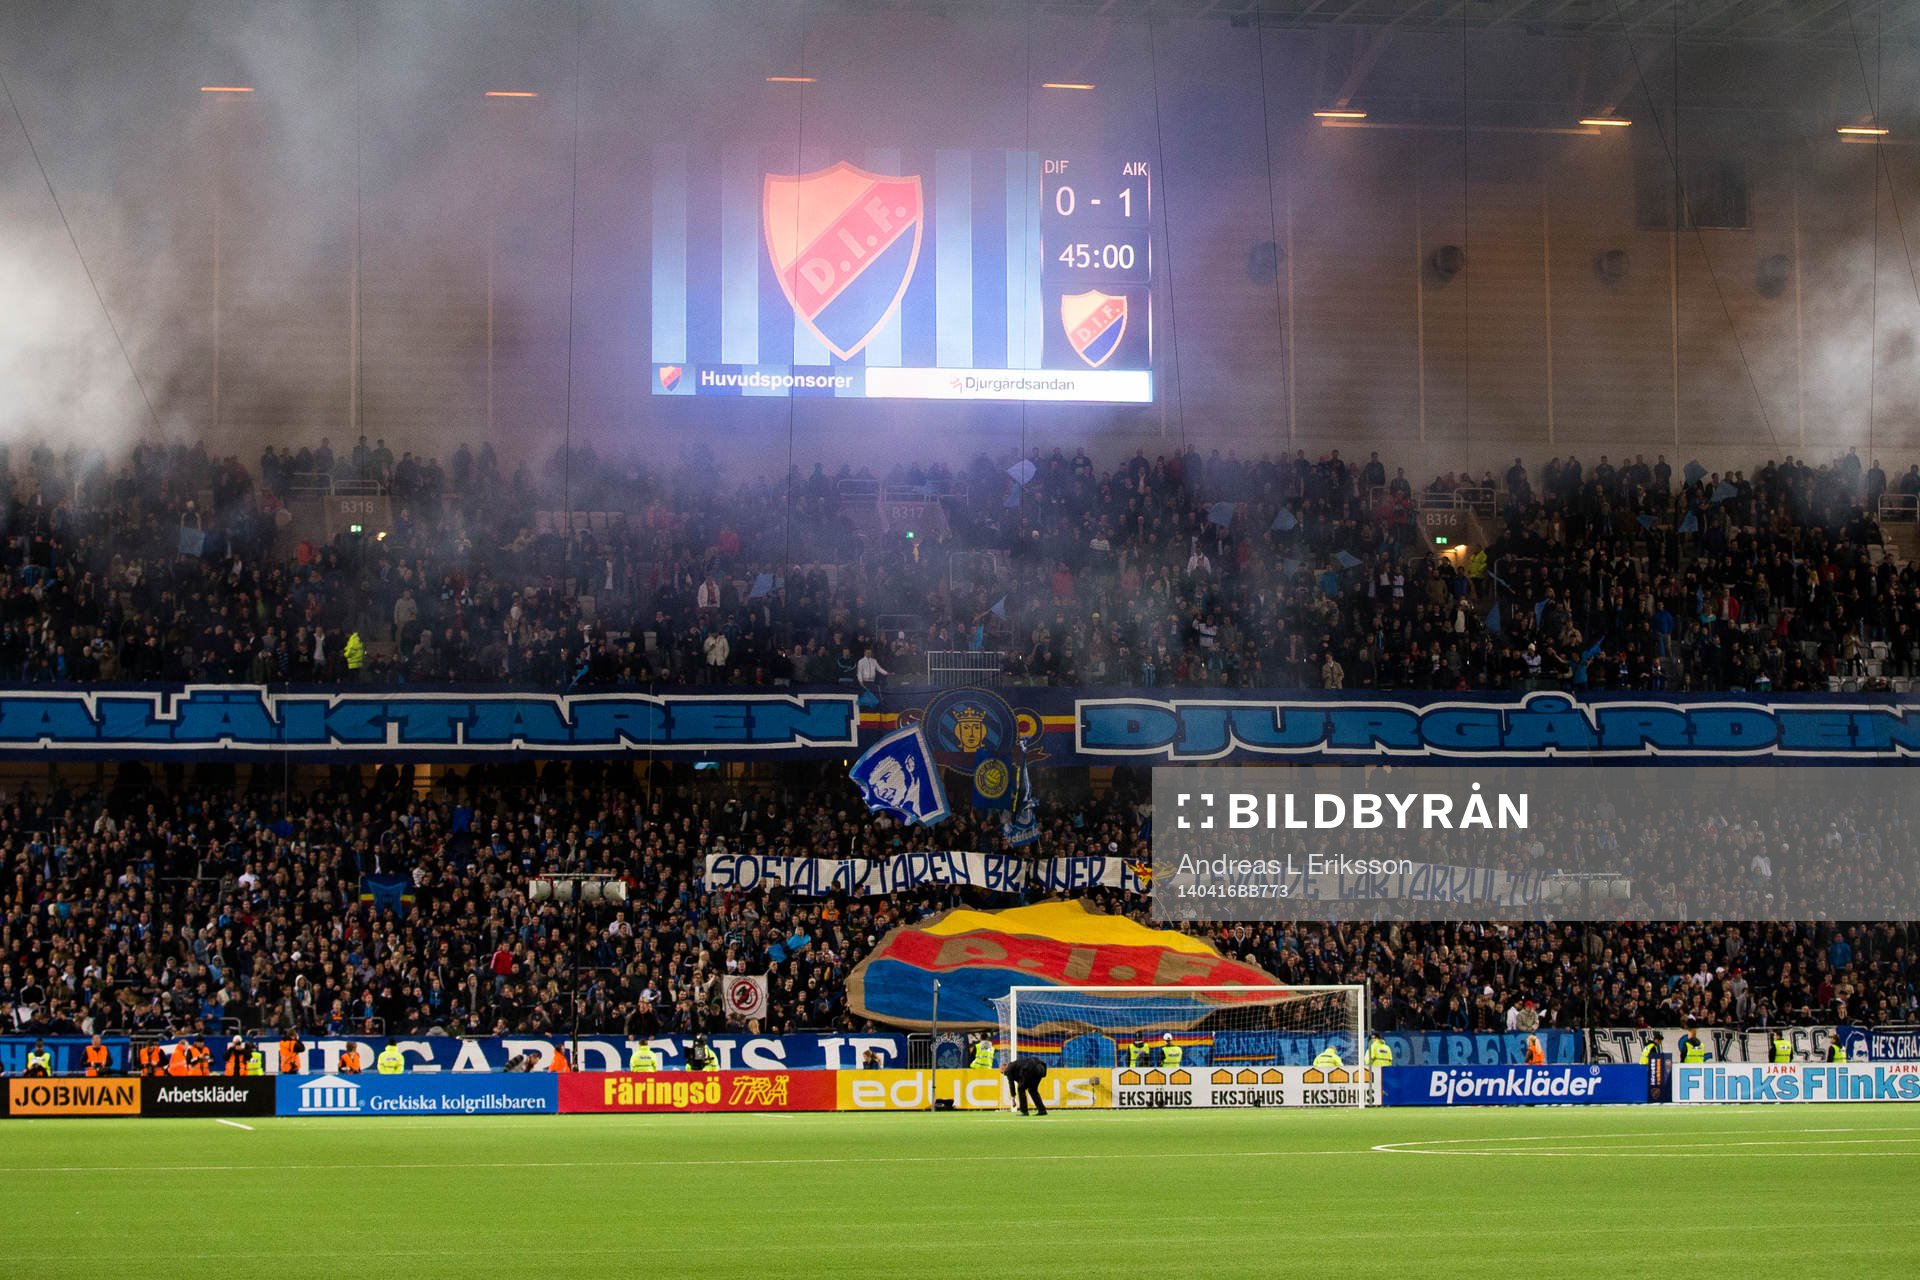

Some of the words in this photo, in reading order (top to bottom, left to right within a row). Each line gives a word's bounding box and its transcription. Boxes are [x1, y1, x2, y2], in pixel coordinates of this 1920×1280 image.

[1044, 160, 1069, 175] DIF
[1123, 162, 1148, 177] AIK
[1055, 186, 1076, 217] 0
[1118, 188, 1133, 218] 1
[801, 195, 907, 296] D.I.F.
[1058, 243, 1135, 271] 45:00
[1077, 304, 1122, 342] D.I.F.
[700, 369, 854, 390] Huvudsponsorer
[1426, 513, 1457, 526] B316
[818, 1038, 898, 1071] IF
[1872, 1035, 1895, 1058] HE'S
[1896, 1036, 1920, 1058] CRA
[604, 1076, 720, 1107] Färingsö
[728, 1075, 789, 1106] TRÄ
[1679, 1067, 1799, 1101] Flinks
[1802, 1066, 1920, 1100] Flinks
[15, 1085, 134, 1106] JOBMAN
[157, 1086, 249, 1104] Arbetskläder
[370, 1094, 437, 1110] Grekiska
[440, 1093, 546, 1113] kolgrillsbaren
[1118, 1087, 1193, 1106] EKSJÖHUS
[1211, 1086, 1284, 1105] EKSJÖHUS
